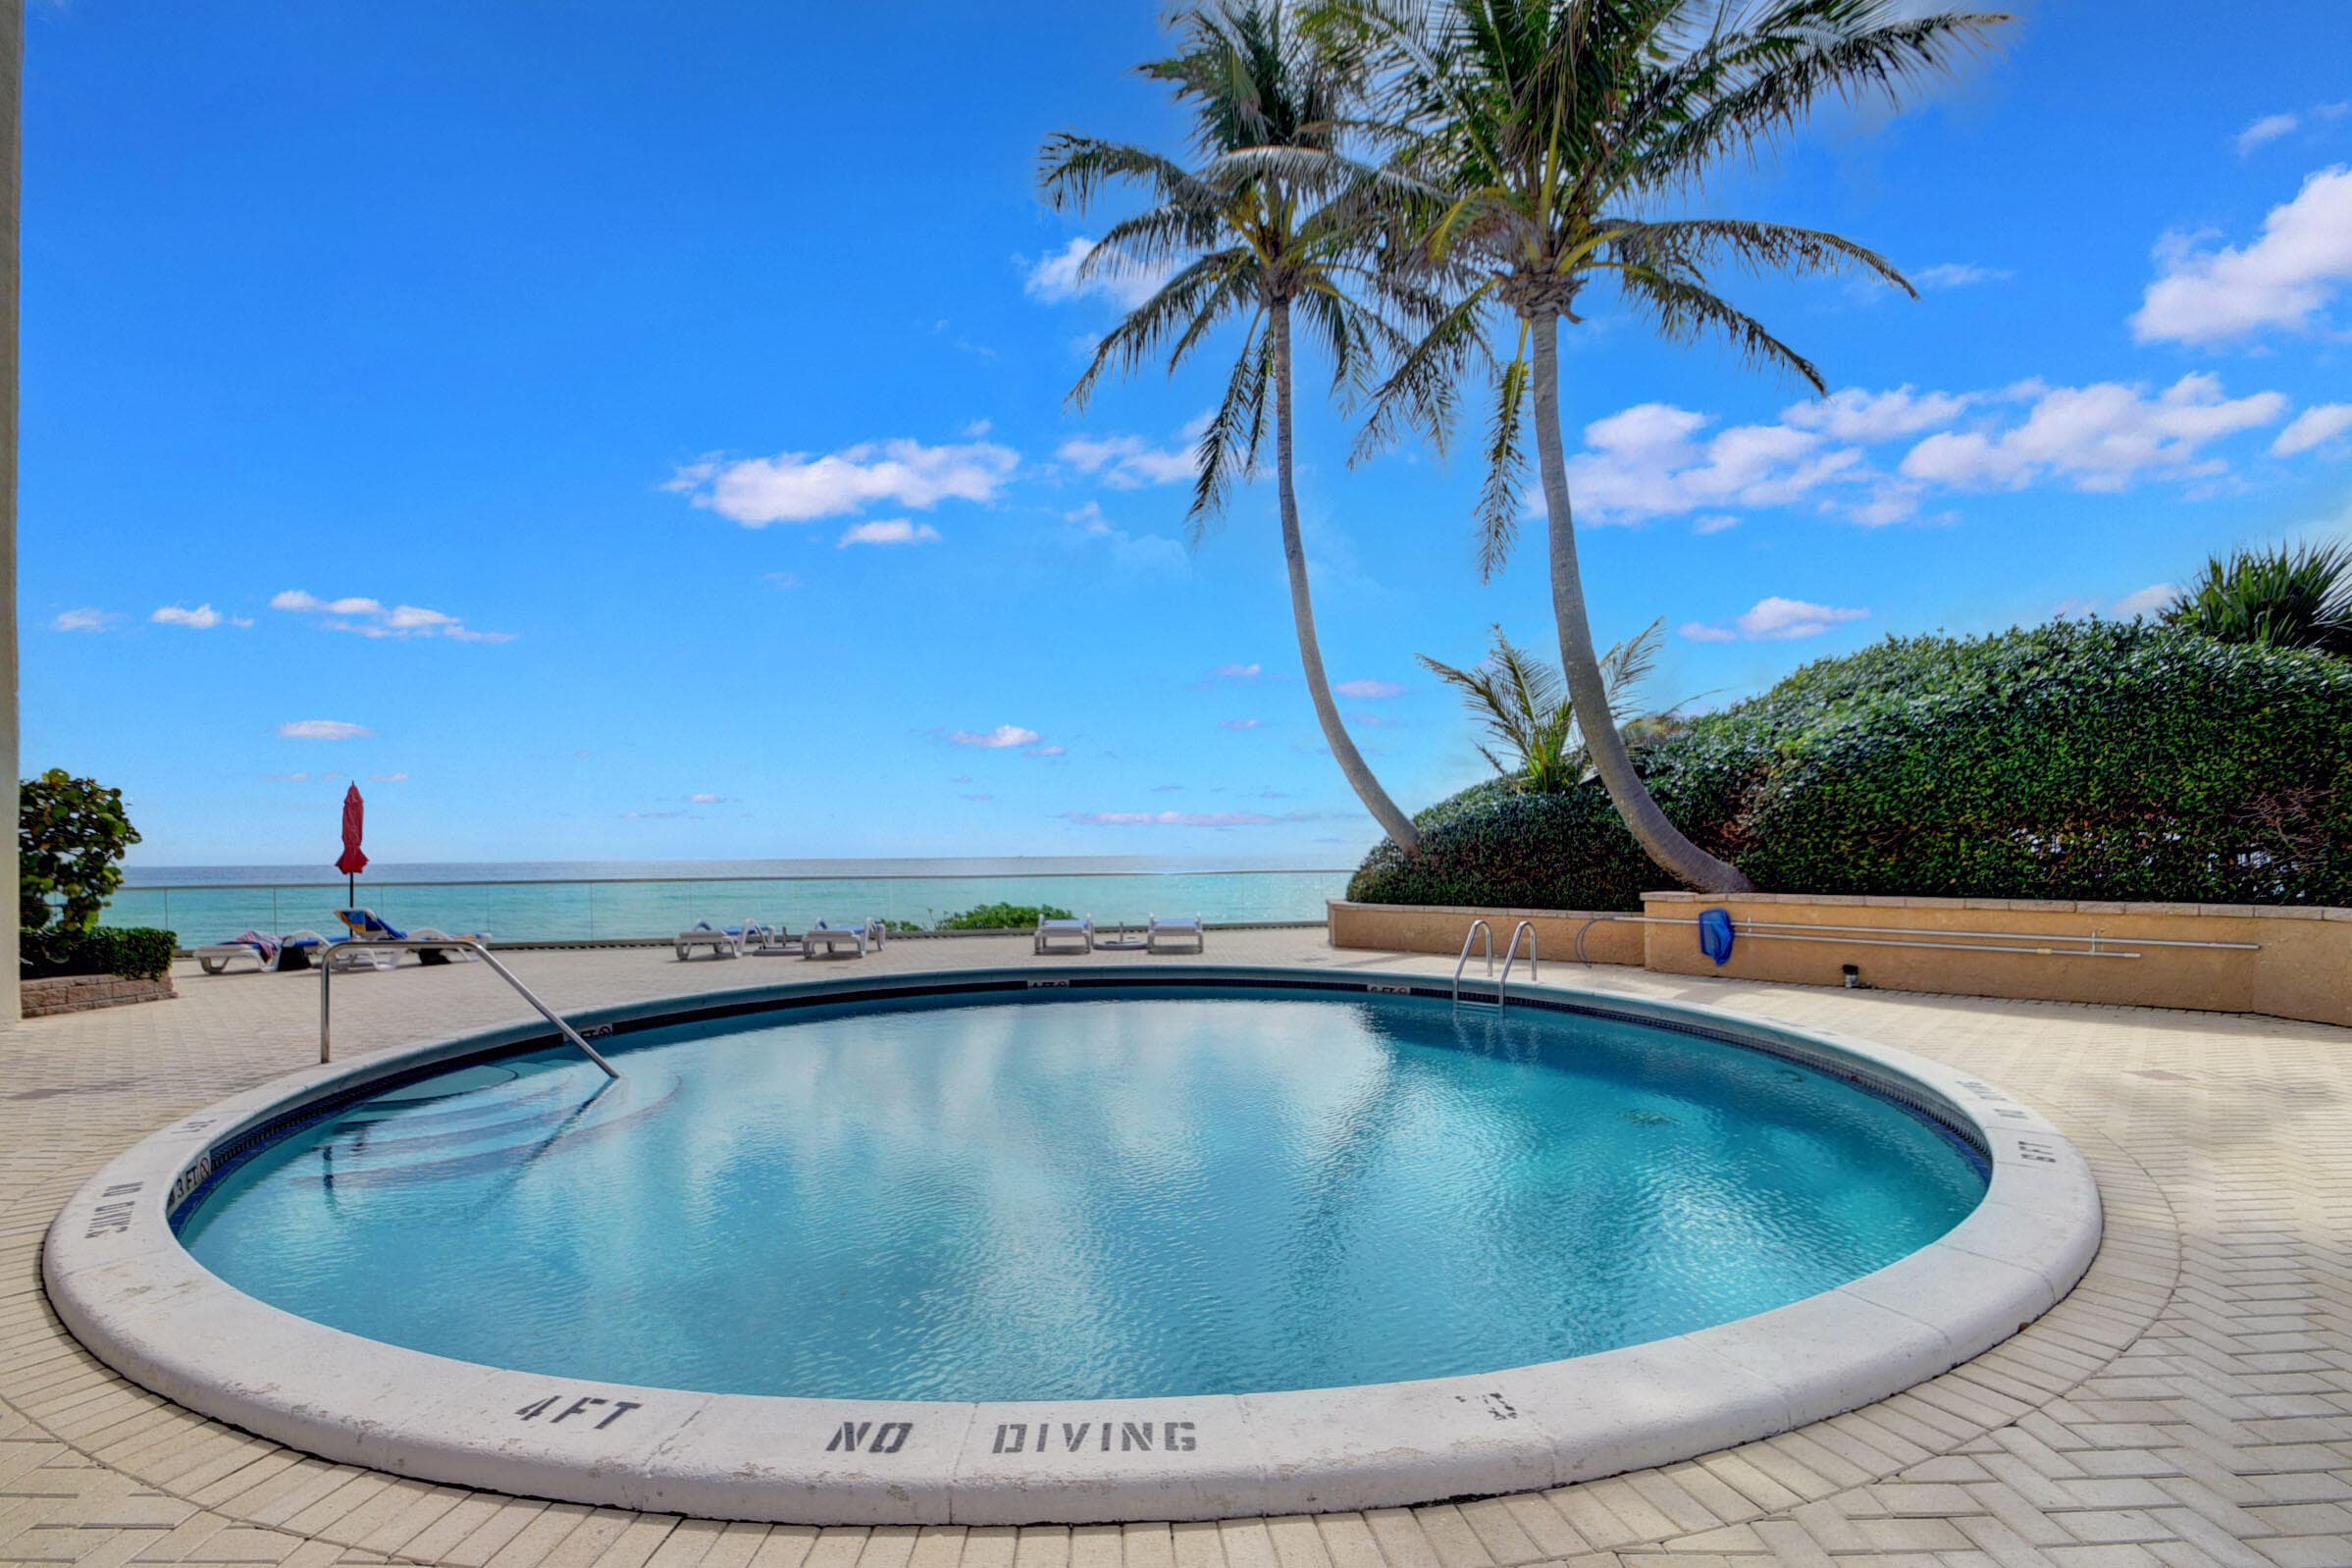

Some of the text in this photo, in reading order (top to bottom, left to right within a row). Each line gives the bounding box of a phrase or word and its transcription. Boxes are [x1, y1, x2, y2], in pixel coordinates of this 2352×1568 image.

[186, 1166, 197, 1190] FT
[514, 1395, 642, 1430] 4FT
[825, 1421, 1196, 1454] NO DIVING
